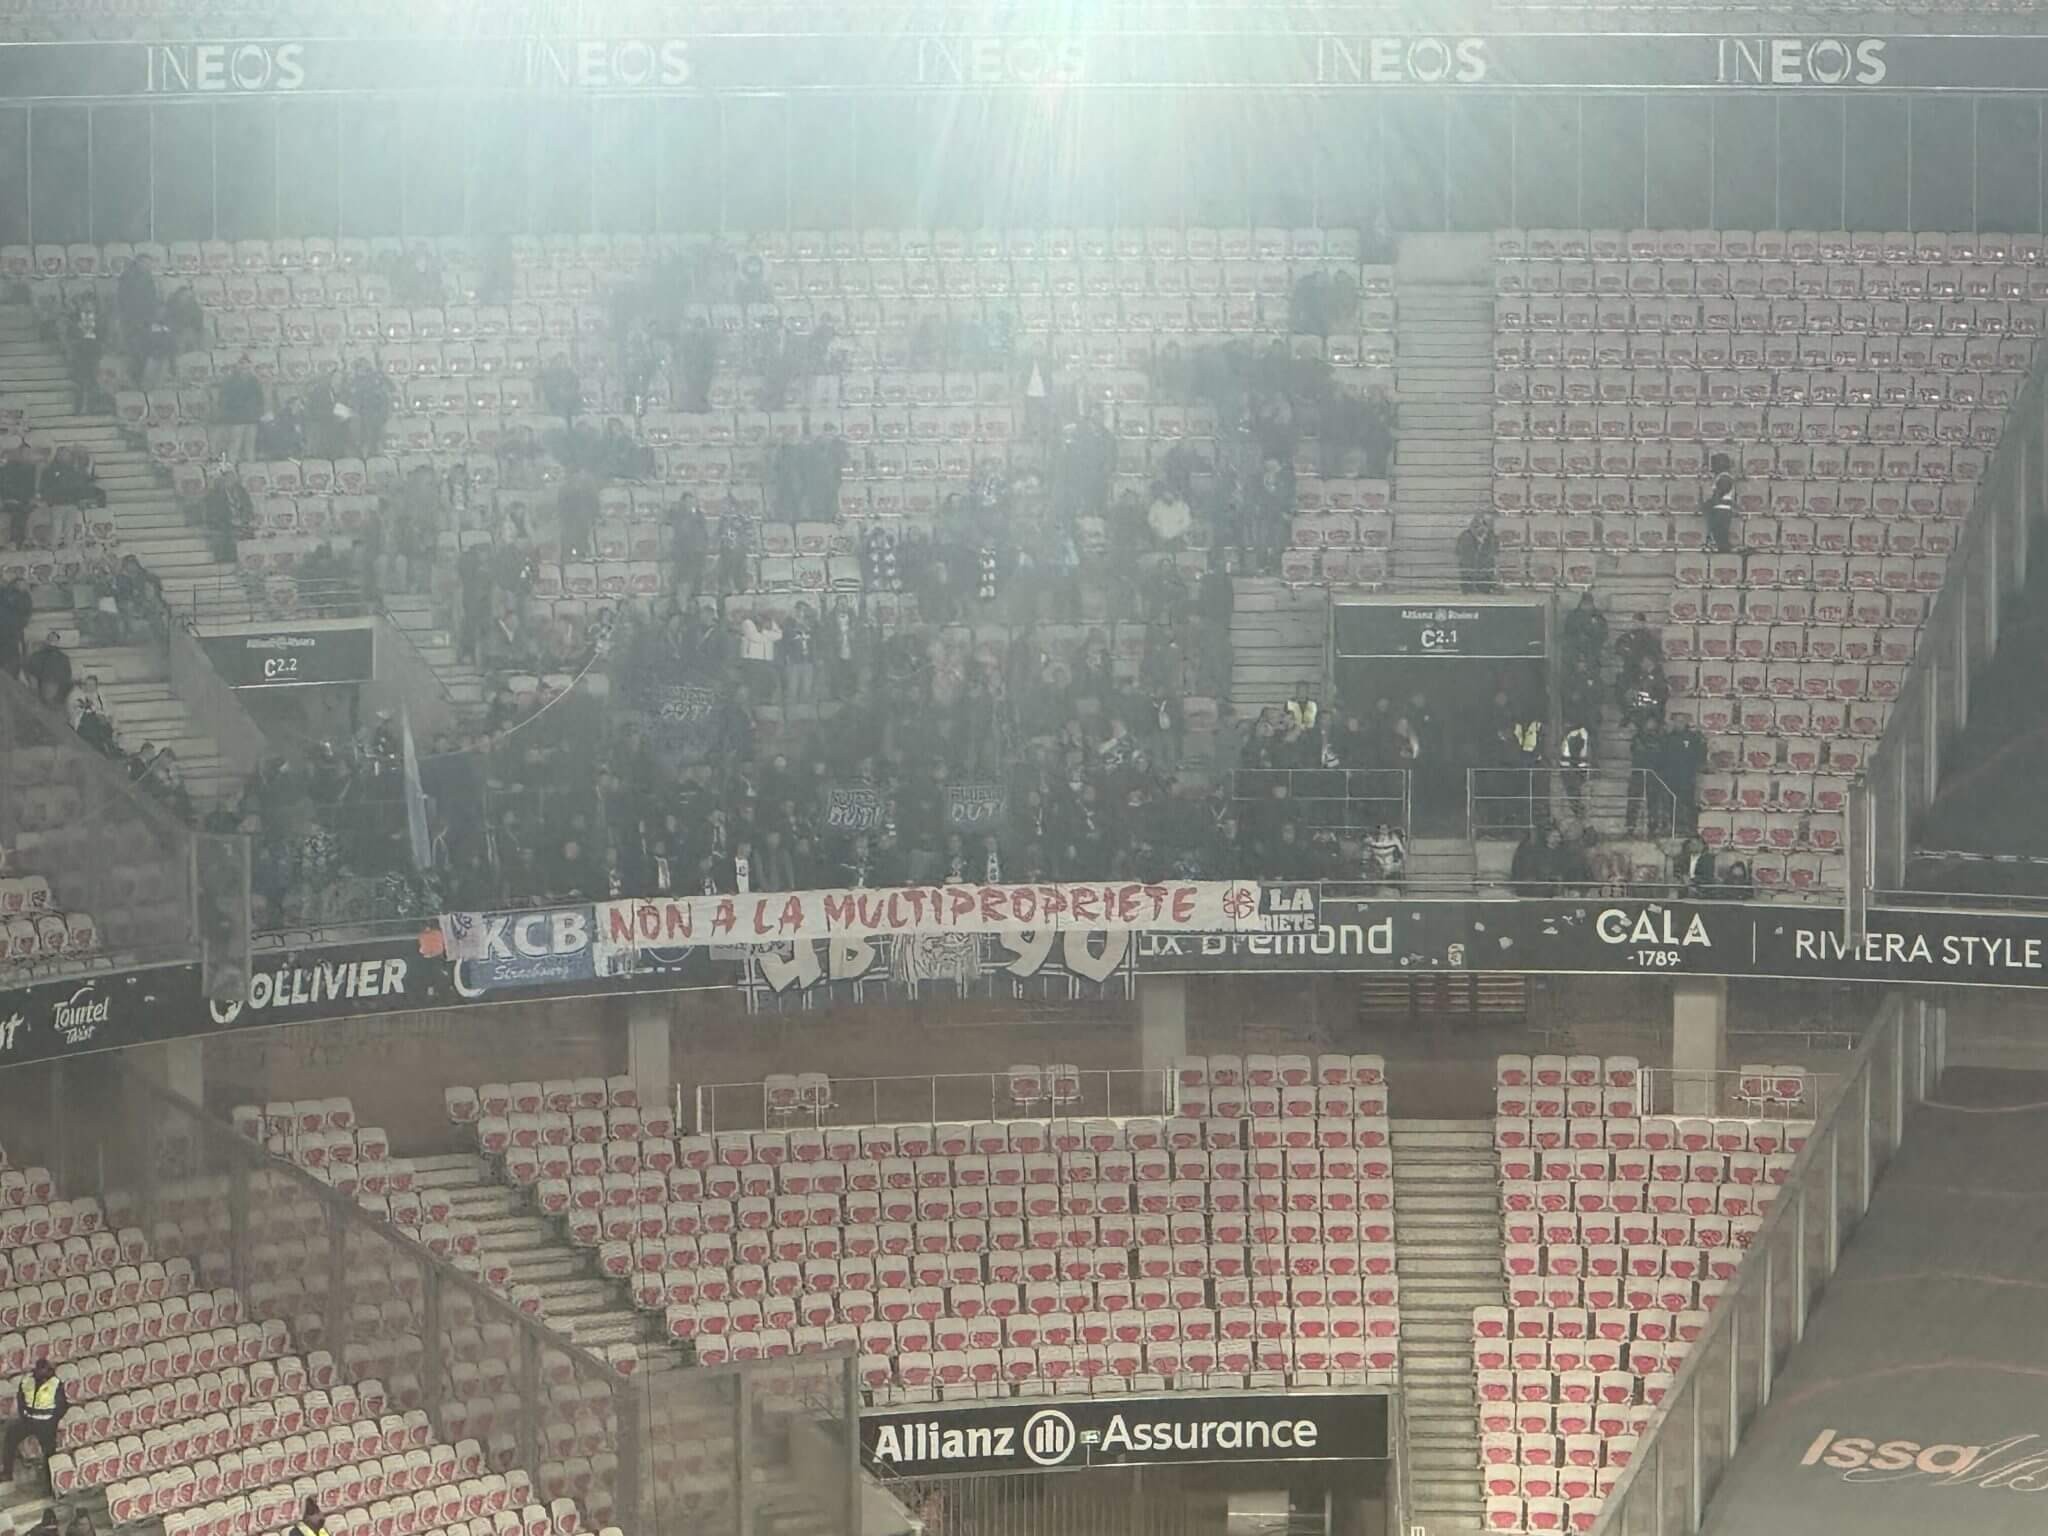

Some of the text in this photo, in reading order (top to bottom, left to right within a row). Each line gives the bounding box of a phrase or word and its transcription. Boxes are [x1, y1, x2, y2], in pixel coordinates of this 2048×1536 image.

[144, 43, 305, 91] INEOS
[524, 38, 690, 86] INEOS
[917, 36, 1086, 83] INEOS
[1316, 36, 1487, 83] INEOS
[1713, 38, 1888, 85] INEOS
[1421, 629, 1457, 648] C2.1
[264, 656, 297, 678] C2.2
[609, 884, 1198, 943] NON A LA MULTIPROPRIETE
[1269, 888, 1314, 911] LA
[480, 912, 588, 961] KCB
[1596, 908, 1712, 947] CALA
[1942, 935, 2043, 968] STYLE
[249, 958, 407, 1009] OLLIVIER
[873, 1414, 1318, 1463] Allianz Assurance
[1800, 1429, 1982, 1474] Issa
